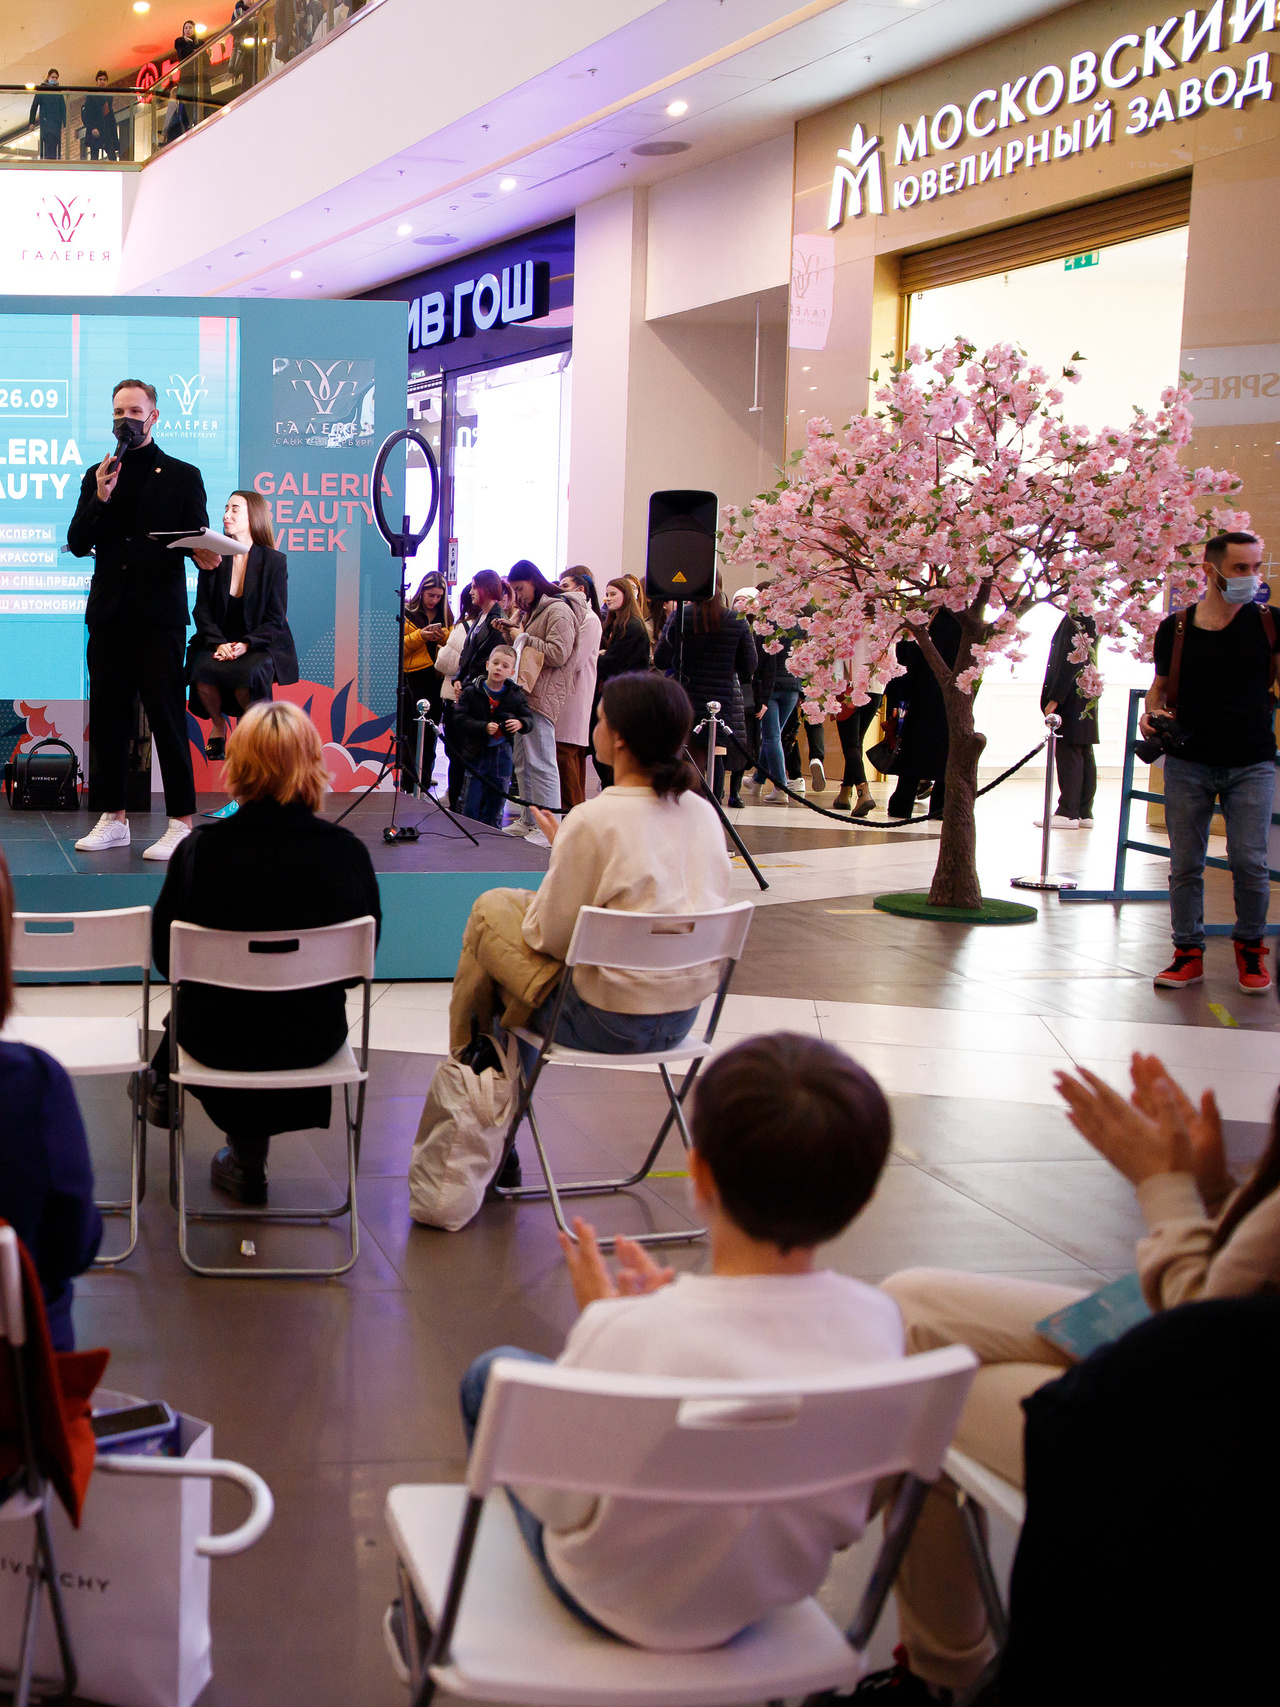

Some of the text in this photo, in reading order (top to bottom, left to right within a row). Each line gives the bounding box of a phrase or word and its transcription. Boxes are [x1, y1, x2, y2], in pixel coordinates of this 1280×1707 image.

[892, 51, 1274, 210] ЮВЕЛИРНЫЙ ЗАВОД
[22, 249, 110, 261] ГАЛЕРЕЯ
[453, 260, 534, 338] ГОШ
[156, 420, 218, 430] ГАЛЕРЕЯ
[253, 472, 394, 497] GALERIA
[0, 552, 54, 563] КРАСОТЫ
[13, 600, 87, 611] АВТОМОБИЛ
